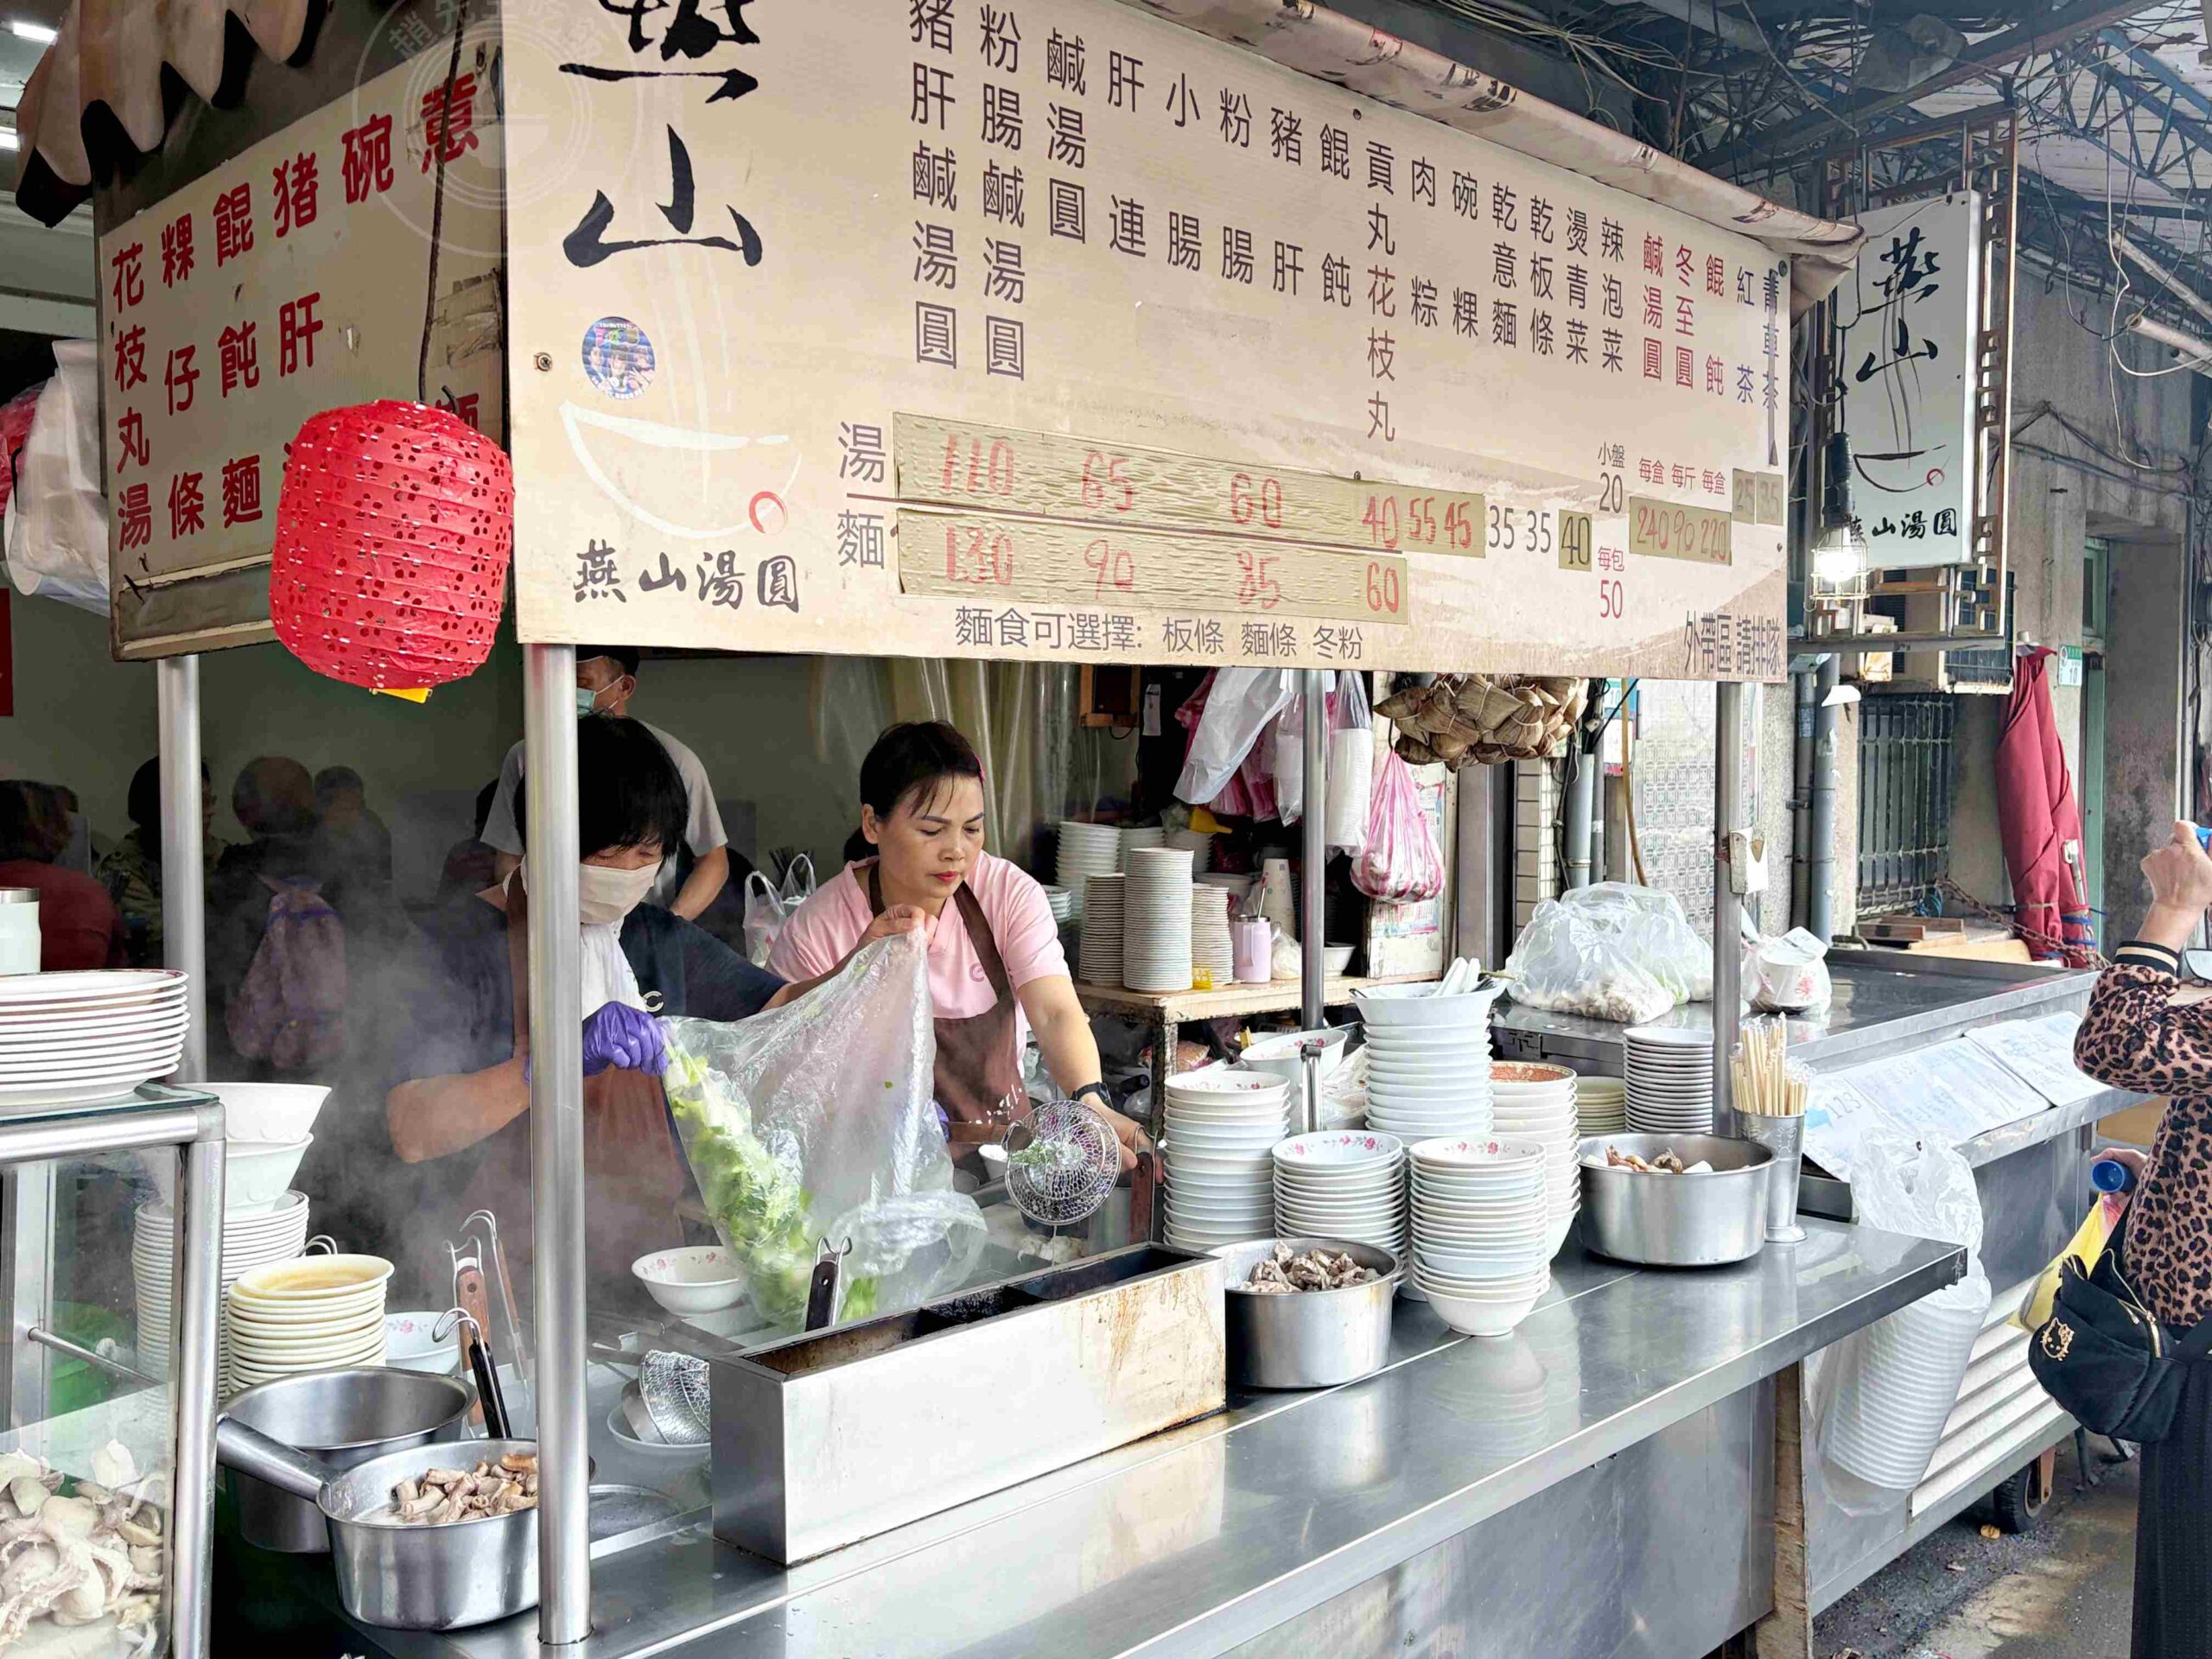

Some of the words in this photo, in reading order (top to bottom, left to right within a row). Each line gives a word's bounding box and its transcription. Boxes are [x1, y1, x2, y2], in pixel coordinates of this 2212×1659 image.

[1046, 27, 1086, 245] 鹹湯圓
[1108, 50, 1146, 257] 肝連
[980, 3, 1025, 381] 粉腸鹹湯圓
[1166, 73, 1202, 271] 小腸
[1220, 87, 1254, 284] 粉腸
[1271, 107, 1304, 296] 豬肝
[1320, 124, 1351, 308] 餛飩
[1411, 156, 1438, 327] 肉粽
[1452, 171, 1478, 338] 碗粿
[1492, 181, 1516, 348] 乾意麵
[1530, 195, 1554, 355] 乾板條
[1602, 217, 1624, 372] 辣泡菜
[1643, 232, 1662, 381] 鹹湯圓
[1675, 244, 1694, 389] 冬至圓
[1706, 254, 1724, 396] 餛飩
[213, 182, 263, 529] 餛飩麵
[1737, 266, 1754, 403] 紅茶
[111, 243, 151, 551] 花枝丸湯
[162, 213, 204, 539] 粿仔條
[838, 422, 886, 483] 湯
[940, 432, 1014, 497] 110
[1080, 450, 1134, 514] 65
[1598, 442, 1624, 468] 小盤
[1639, 458, 1664, 484] 每盒
[1702, 469, 1725, 495] 每盒
[1230, 472, 1282, 530] 60
[1362, 495, 1399, 550] 40
[1408, 496, 1436, 545] 55
[1489, 505, 1514, 550] 35
[1599, 473, 1623, 513] 20
[837, 509, 884, 569] 麵
[1527, 510, 1551, 553] 35
[1560, 516, 1591, 565] 40
[1598, 546, 1624, 571] 每包
[573, 539, 799, 613] 燕山湯圓
[1084, 537, 1135, 601] 90
[1236, 550, 1281, 610] 85
[1366, 562, 1400, 613] 60
[1600, 580, 1623, 619] 50
[1162, 616, 1224, 654] 板條
[1242, 621, 1296, 657] 麵條
[1313, 625, 1363, 659] 冬粉
